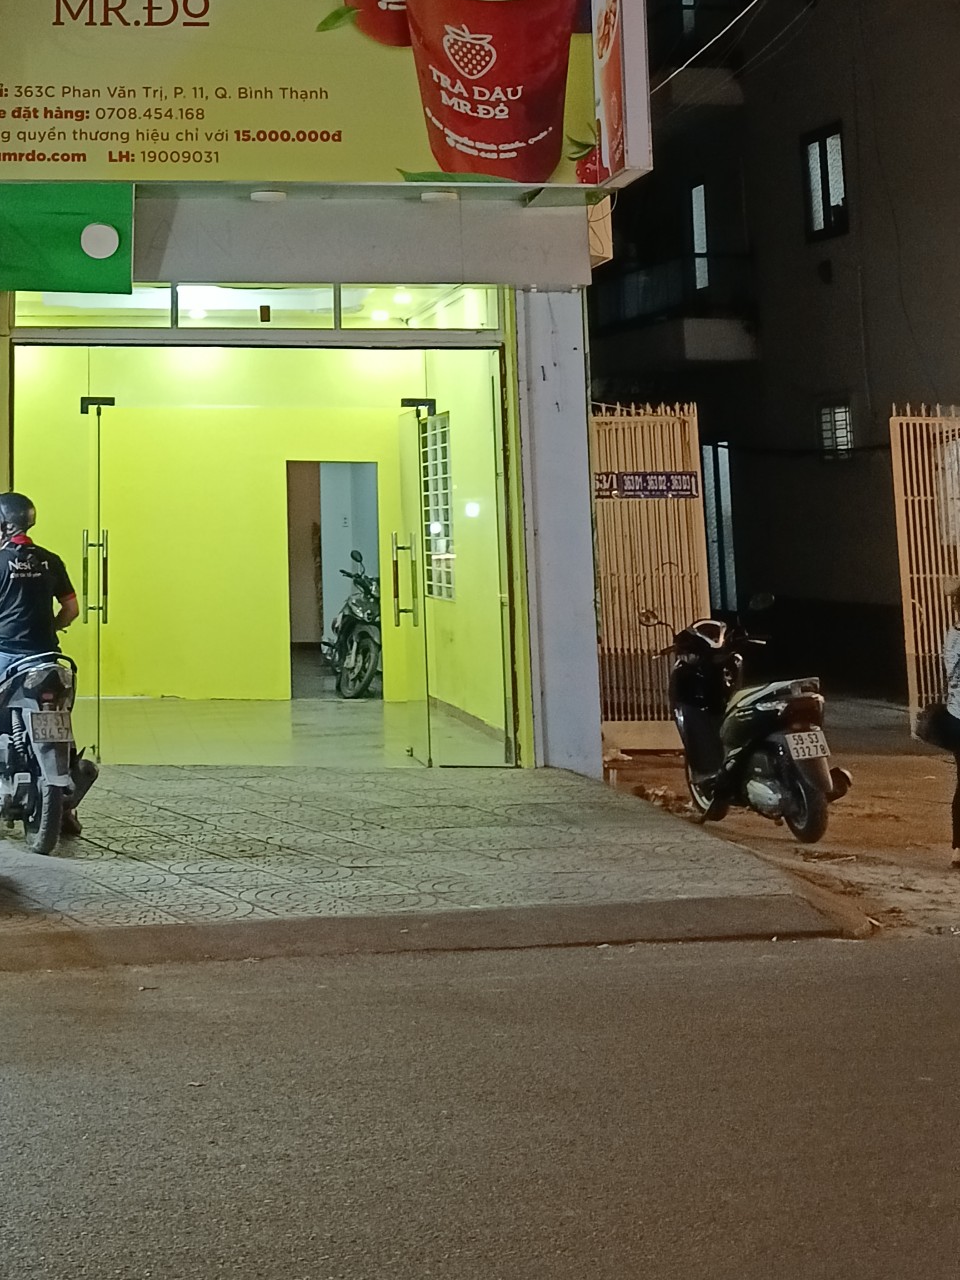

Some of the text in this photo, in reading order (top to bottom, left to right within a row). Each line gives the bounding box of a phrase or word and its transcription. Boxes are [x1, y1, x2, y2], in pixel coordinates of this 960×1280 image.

[14, 85, 55, 98] 363C
[61, 85, 101, 99] Phan
[107, 86, 136, 99] Văn
[143, 86, 168, 101] Trị,
[173, 86, 186, 99] P.
[192, 86, 209, 101] 11,
[214, 86, 231, 100] Q.
[238, 87, 273, 100] Bình
[279, 87, 329, 102] Thạnh
[11, 106, 39, 122] đặt
[43, 106, 90, 122] hàng:
[95, 107, 205, 120] 0708.454.168
[72, 129, 130, 143] thương
[136, 129, 170, 144] hiệu
[175, 128, 199, 142] chỉ
[205, 129, 229, 142] với
[234, 129, 342, 143] 15.000.000đ
[108, 150, 135, 163] LH:
[141, 150, 219, 163] 19009031
